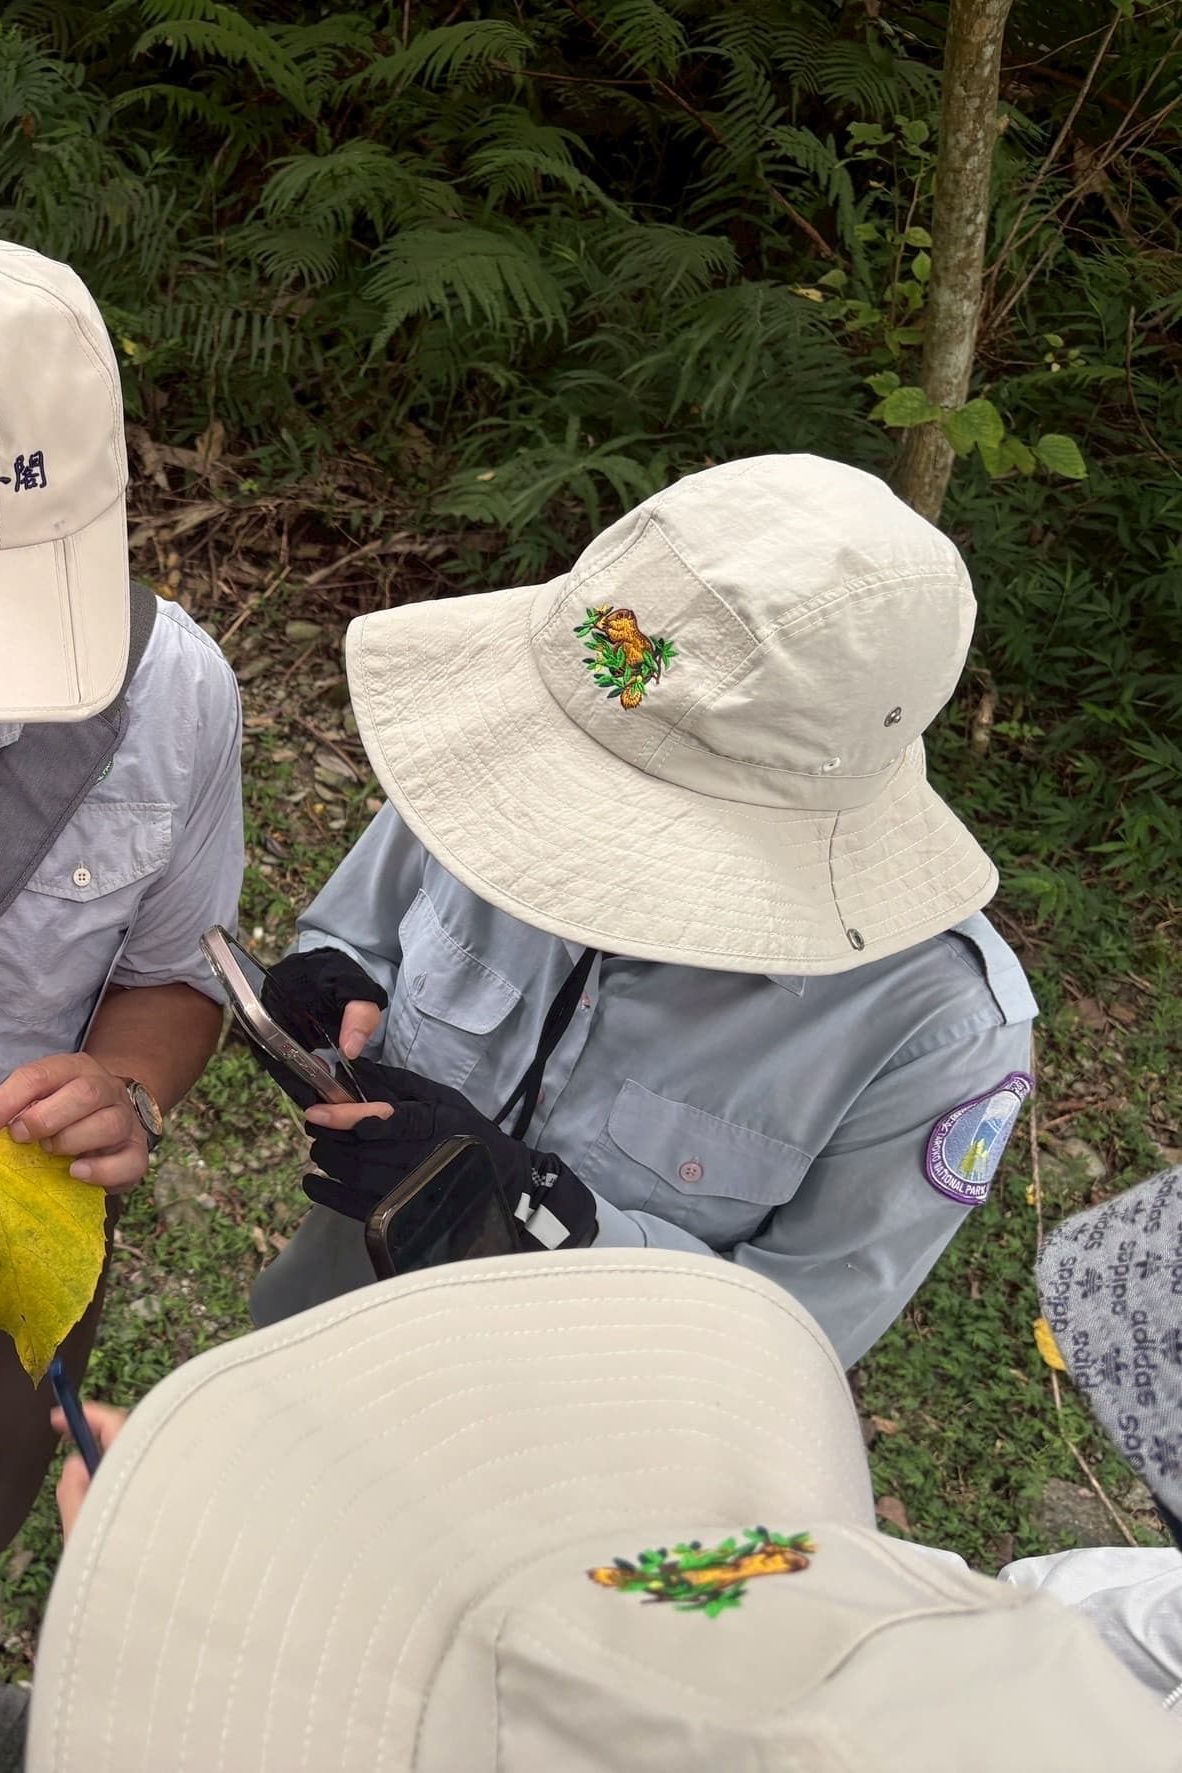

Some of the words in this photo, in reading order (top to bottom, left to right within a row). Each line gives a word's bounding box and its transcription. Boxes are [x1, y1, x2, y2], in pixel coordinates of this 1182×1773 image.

[931, 1131, 946, 1162] TAROKO
[933, 1162, 964, 1193] NATIONAL
[965, 1184, 986, 1196] PARK
[1047, 1256, 1076, 1332] adidas
[1108, 1240, 1136, 1315] adidas
[1132, 1310, 1157, 1406] adidas
